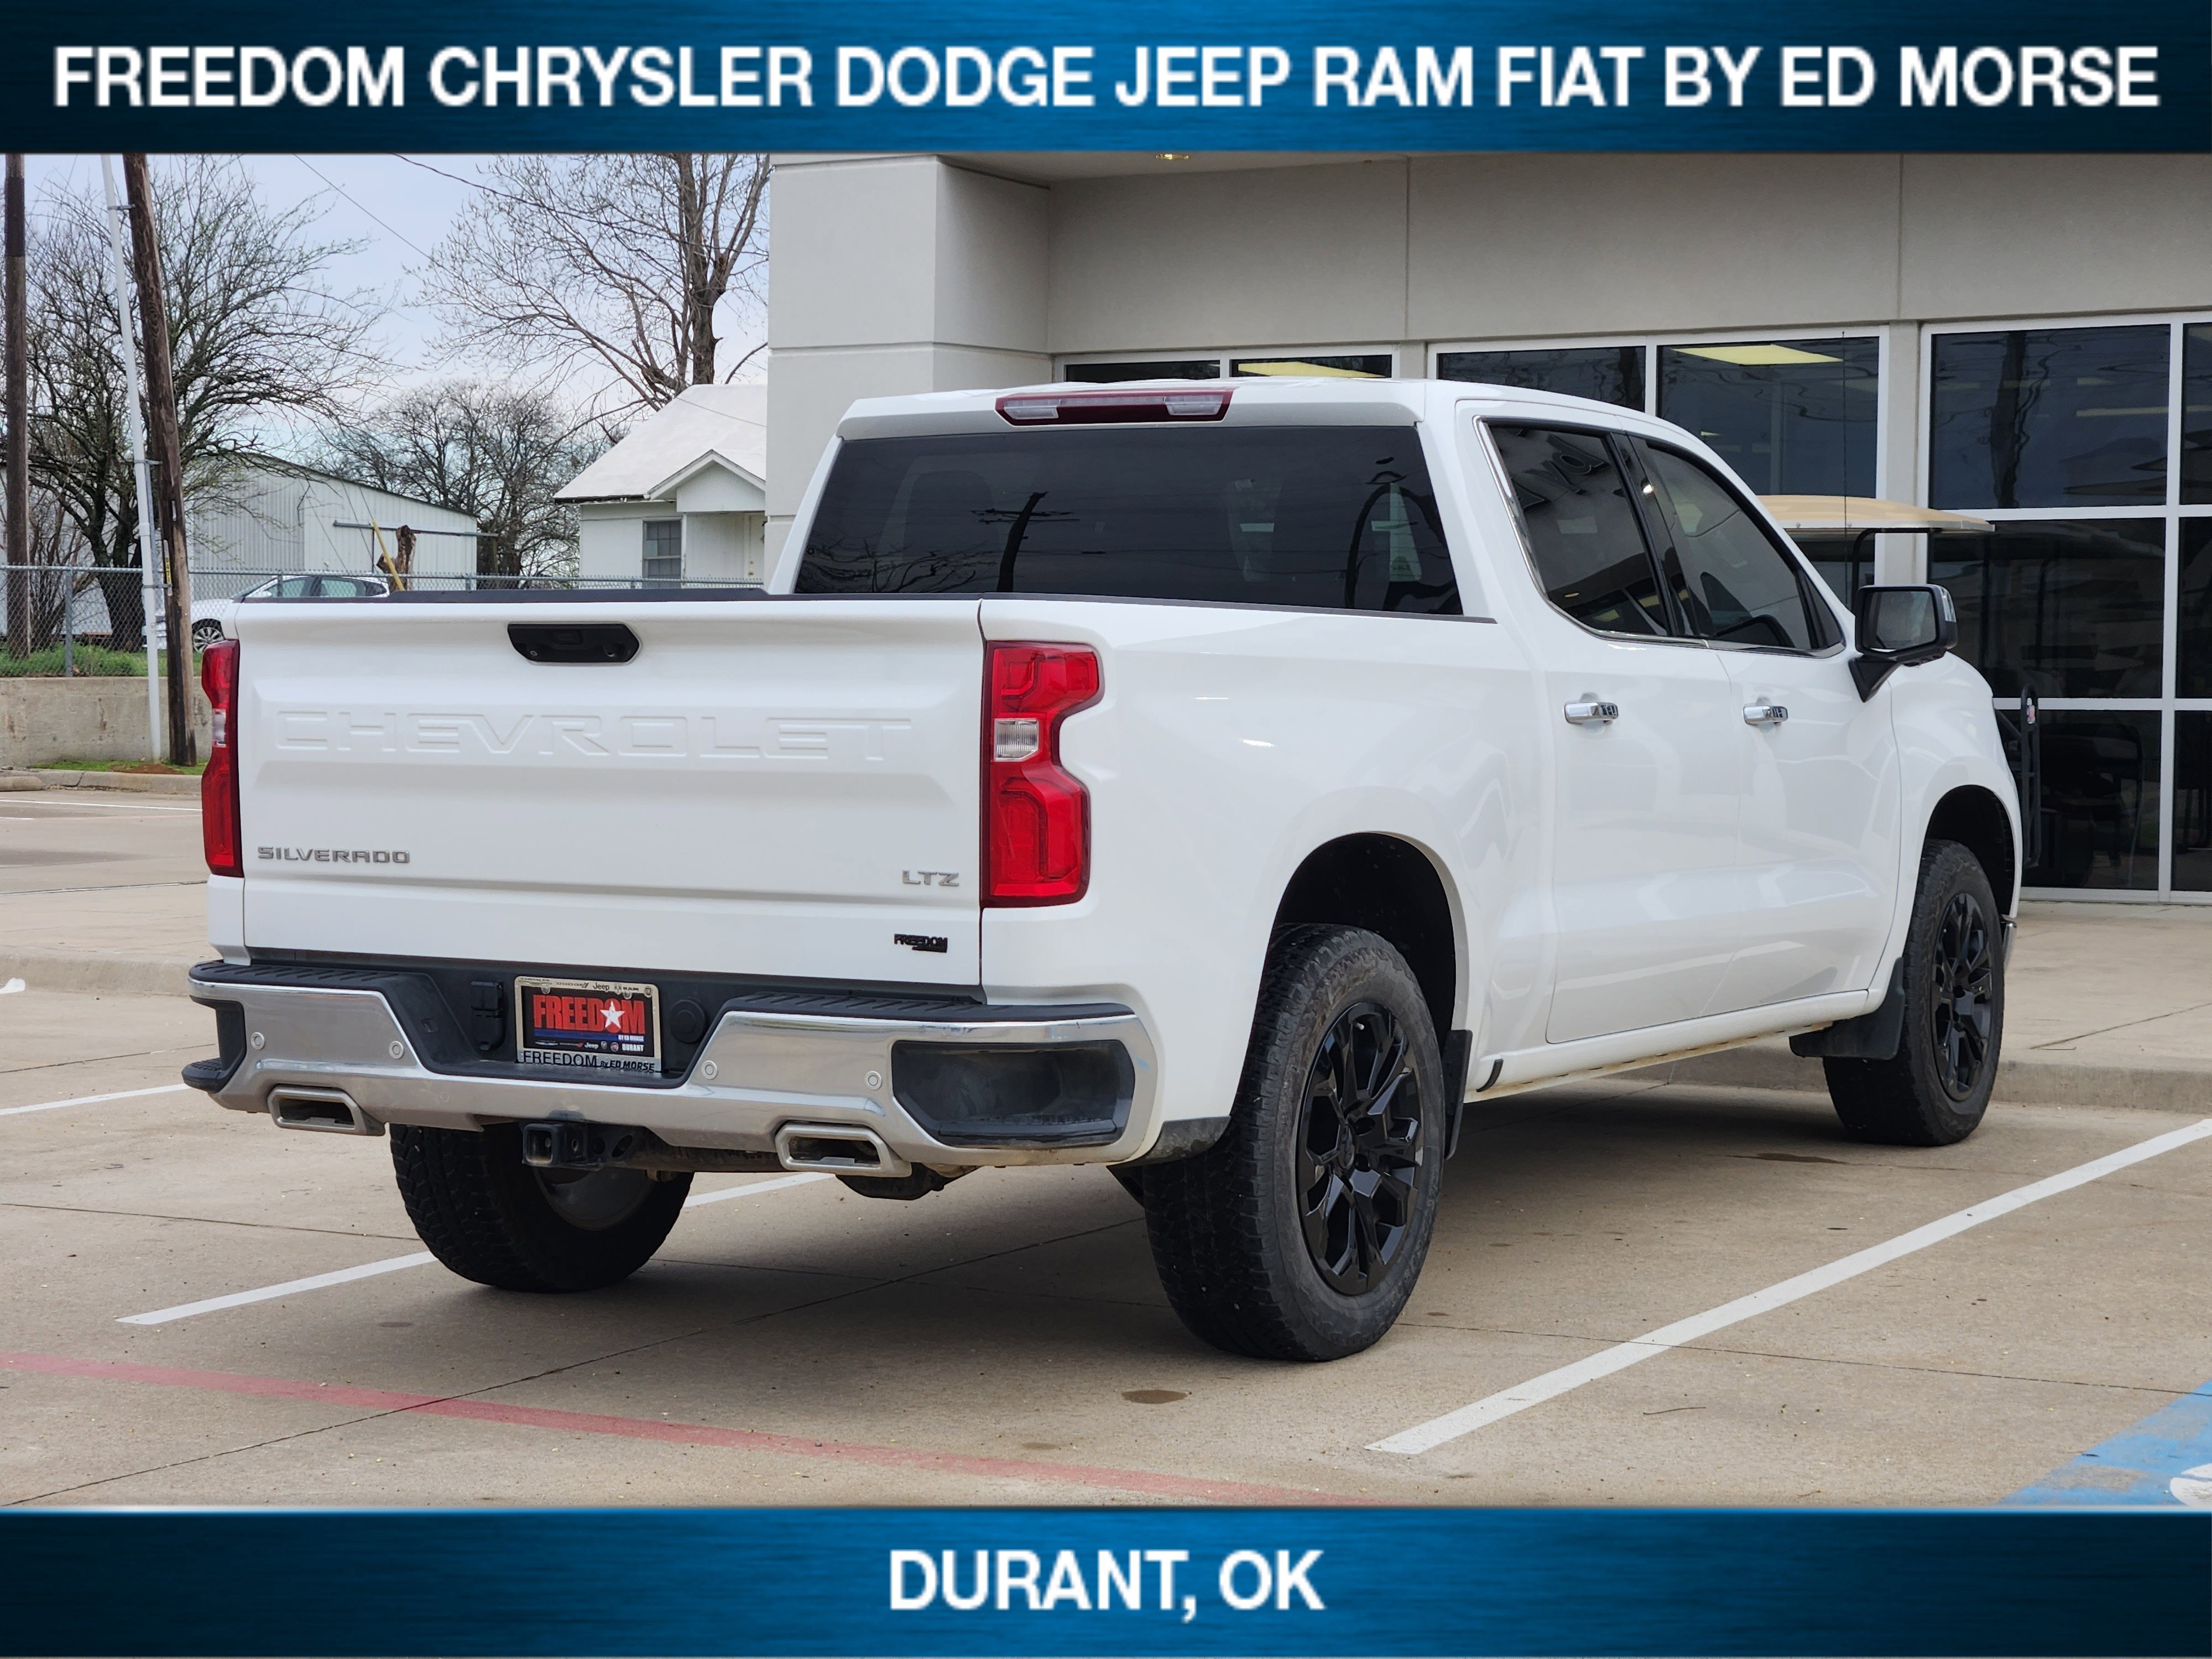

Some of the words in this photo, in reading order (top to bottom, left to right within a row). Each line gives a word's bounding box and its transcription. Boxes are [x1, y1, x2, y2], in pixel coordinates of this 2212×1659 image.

[275, 711, 912, 761] CHEVROLET
[258, 846, 410, 864] SILVERADO
[902, 870, 959, 887] LTZ
[593, 983, 609, 991] Jeep
[533, 994, 645, 1034] FREEDOM
[622, 1043, 644, 1051] DURANT
[524, 1051, 597, 1067] FREEDOM
[610, 1060, 621, 1069] ED
[623, 1061, 655, 1072] MORSE
